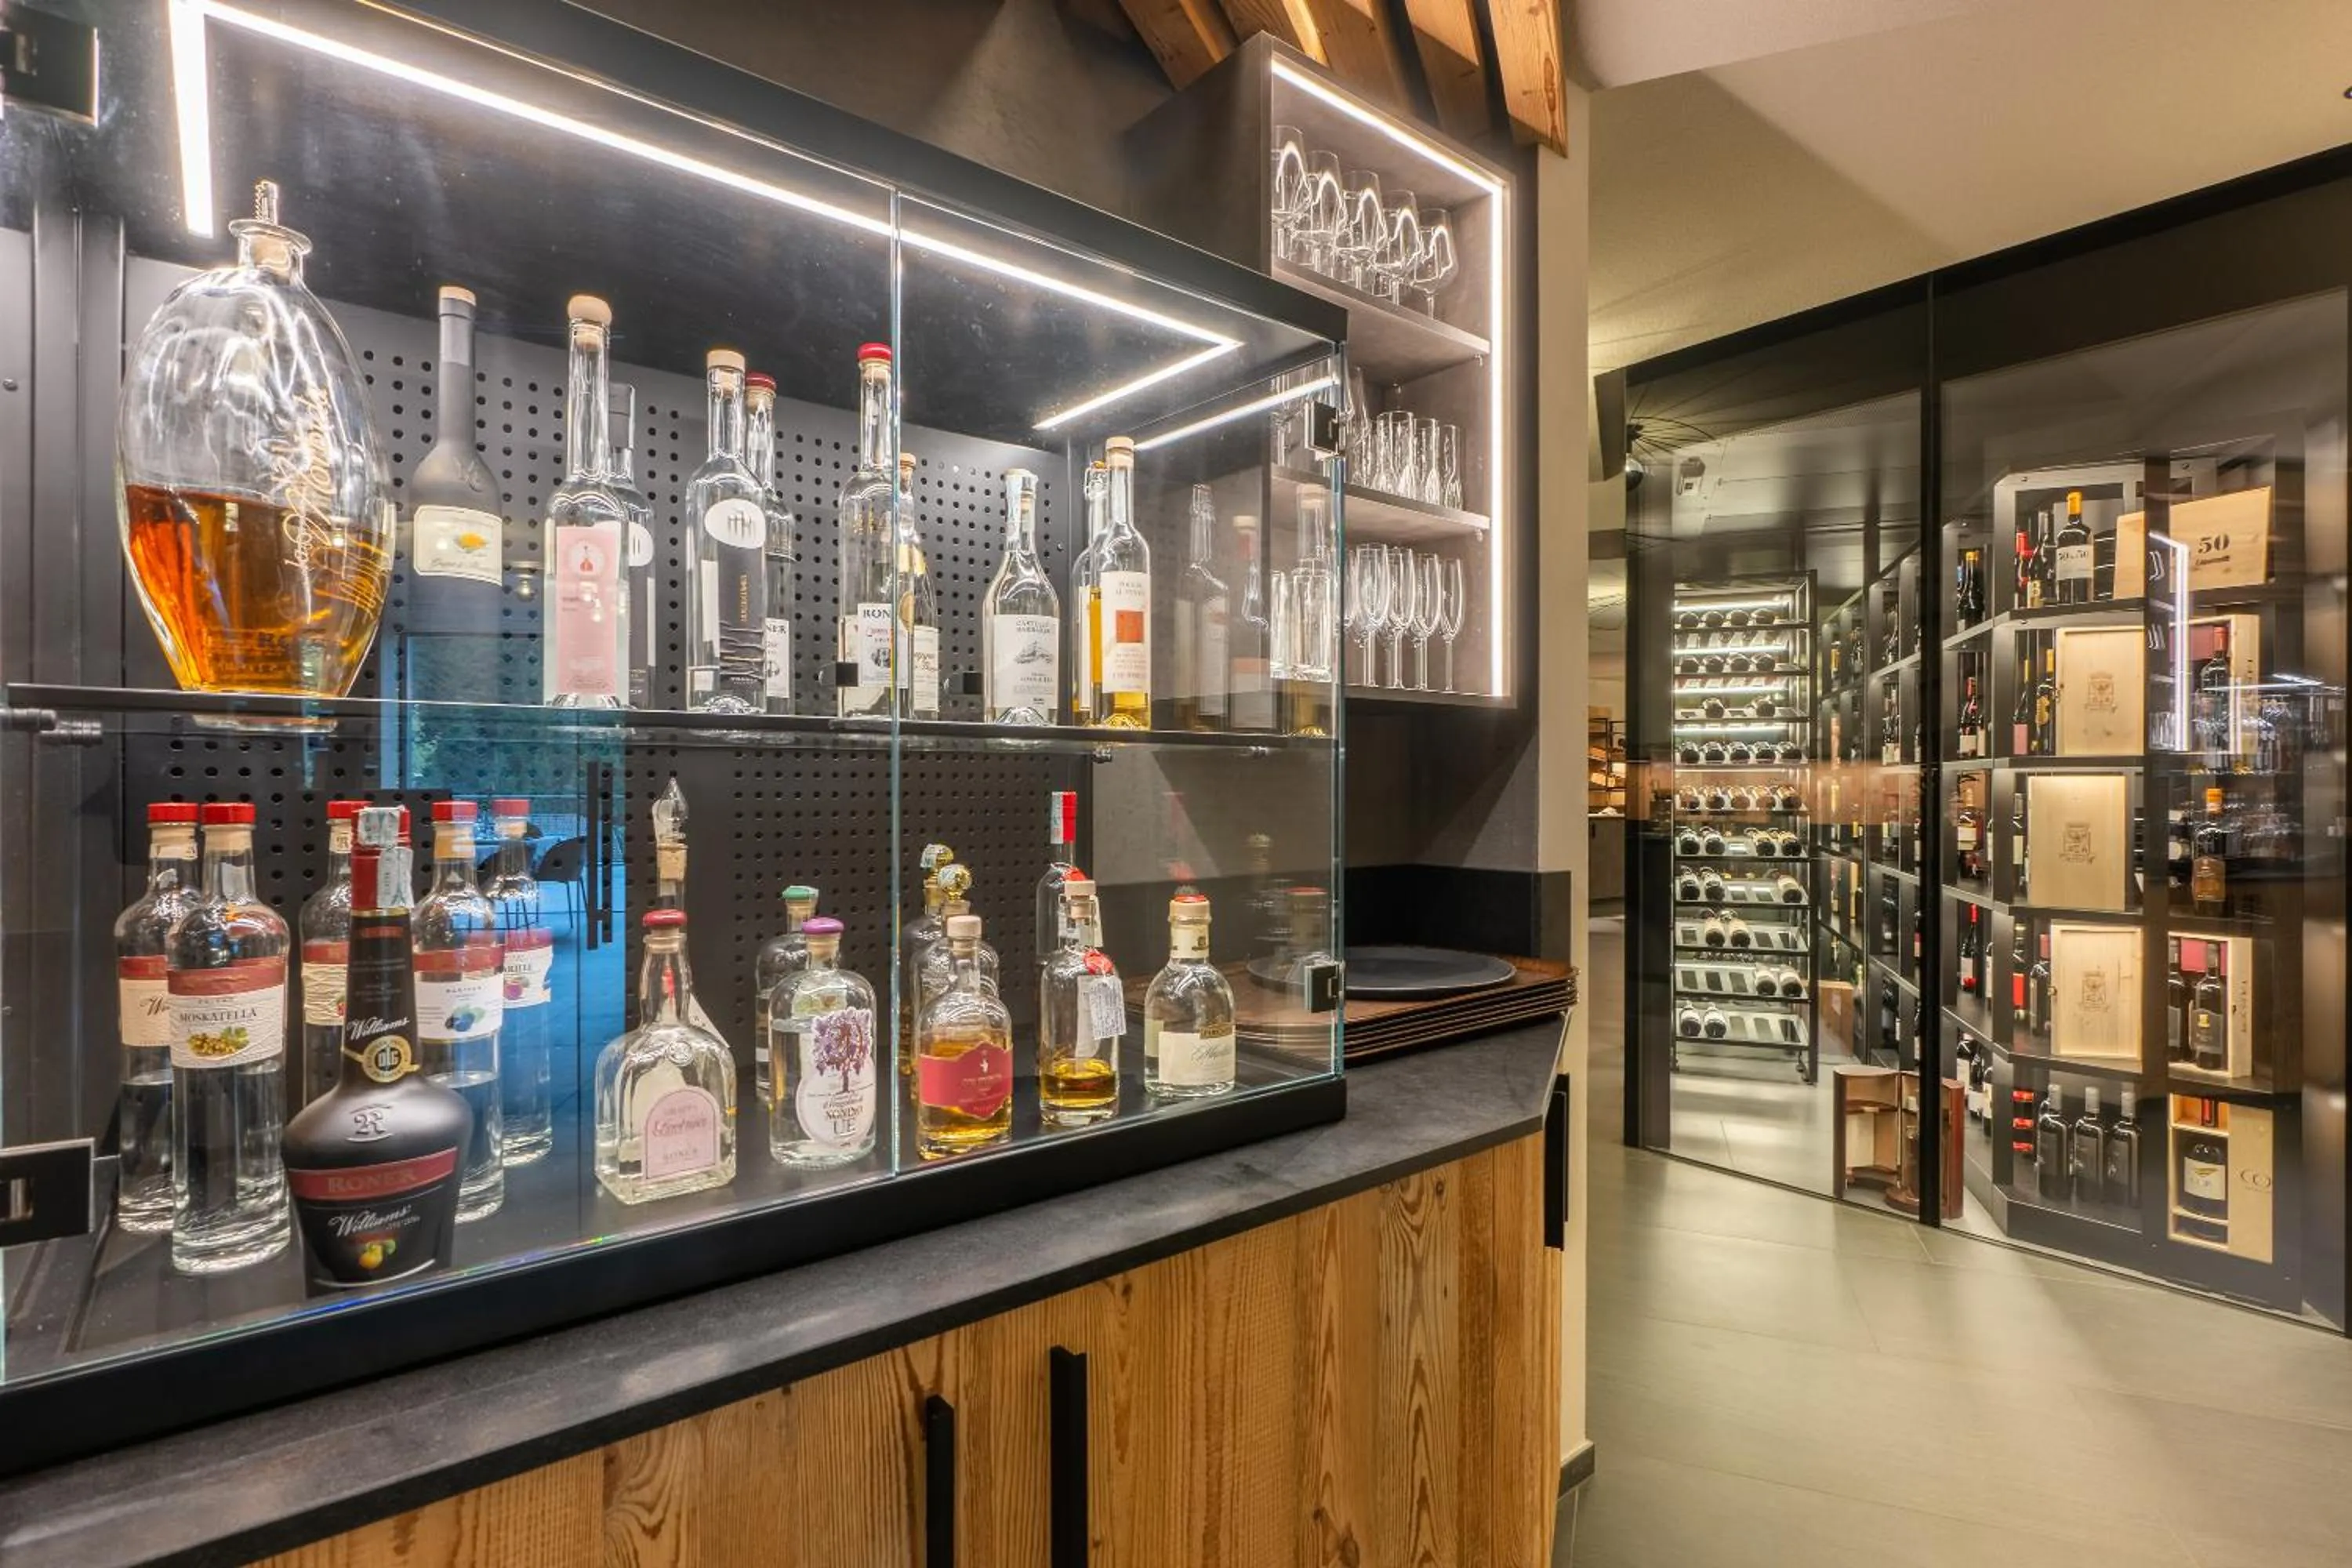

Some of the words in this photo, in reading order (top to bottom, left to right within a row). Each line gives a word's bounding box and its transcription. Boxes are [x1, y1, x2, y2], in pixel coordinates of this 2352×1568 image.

[2198, 535, 2230, 554] 50
[863, 608, 892, 619] RON
[766, 624, 787, 634] NER
[503, 964, 532, 974] ARILLE
[346, 1016, 410, 1040] Williams
[327, 1169, 416, 1193] RONER
